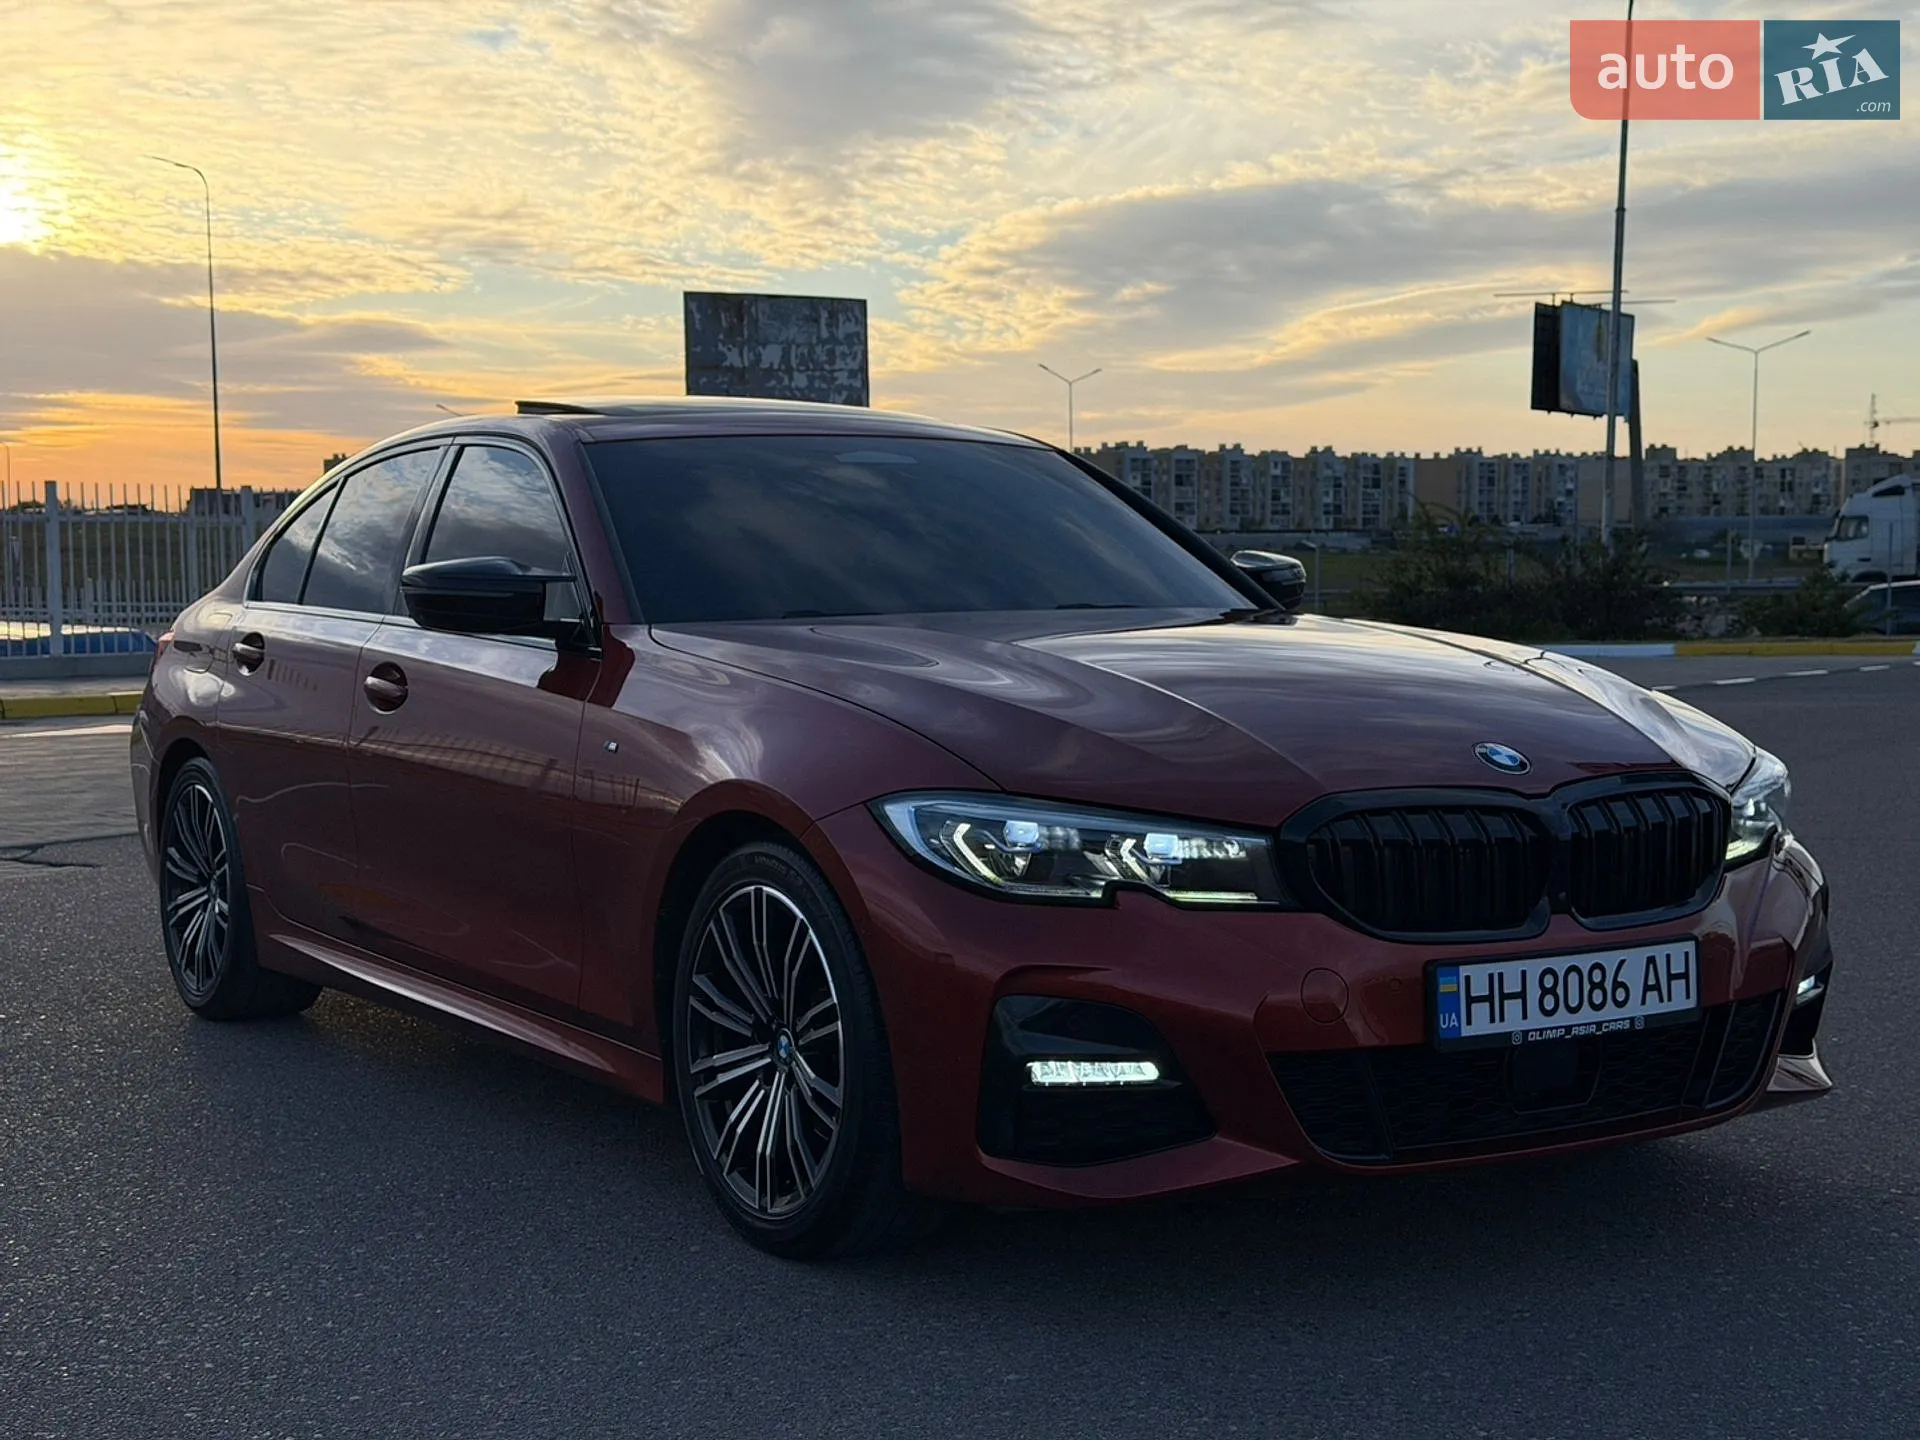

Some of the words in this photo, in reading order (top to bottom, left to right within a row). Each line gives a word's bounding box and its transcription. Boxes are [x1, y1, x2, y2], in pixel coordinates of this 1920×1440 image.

[1464, 969, 1528, 1026] HH
[1538, 958, 1630, 1017] 8086
[1640, 951, 1691, 1006] AH
[1439, 1011, 1459, 1029] UA
